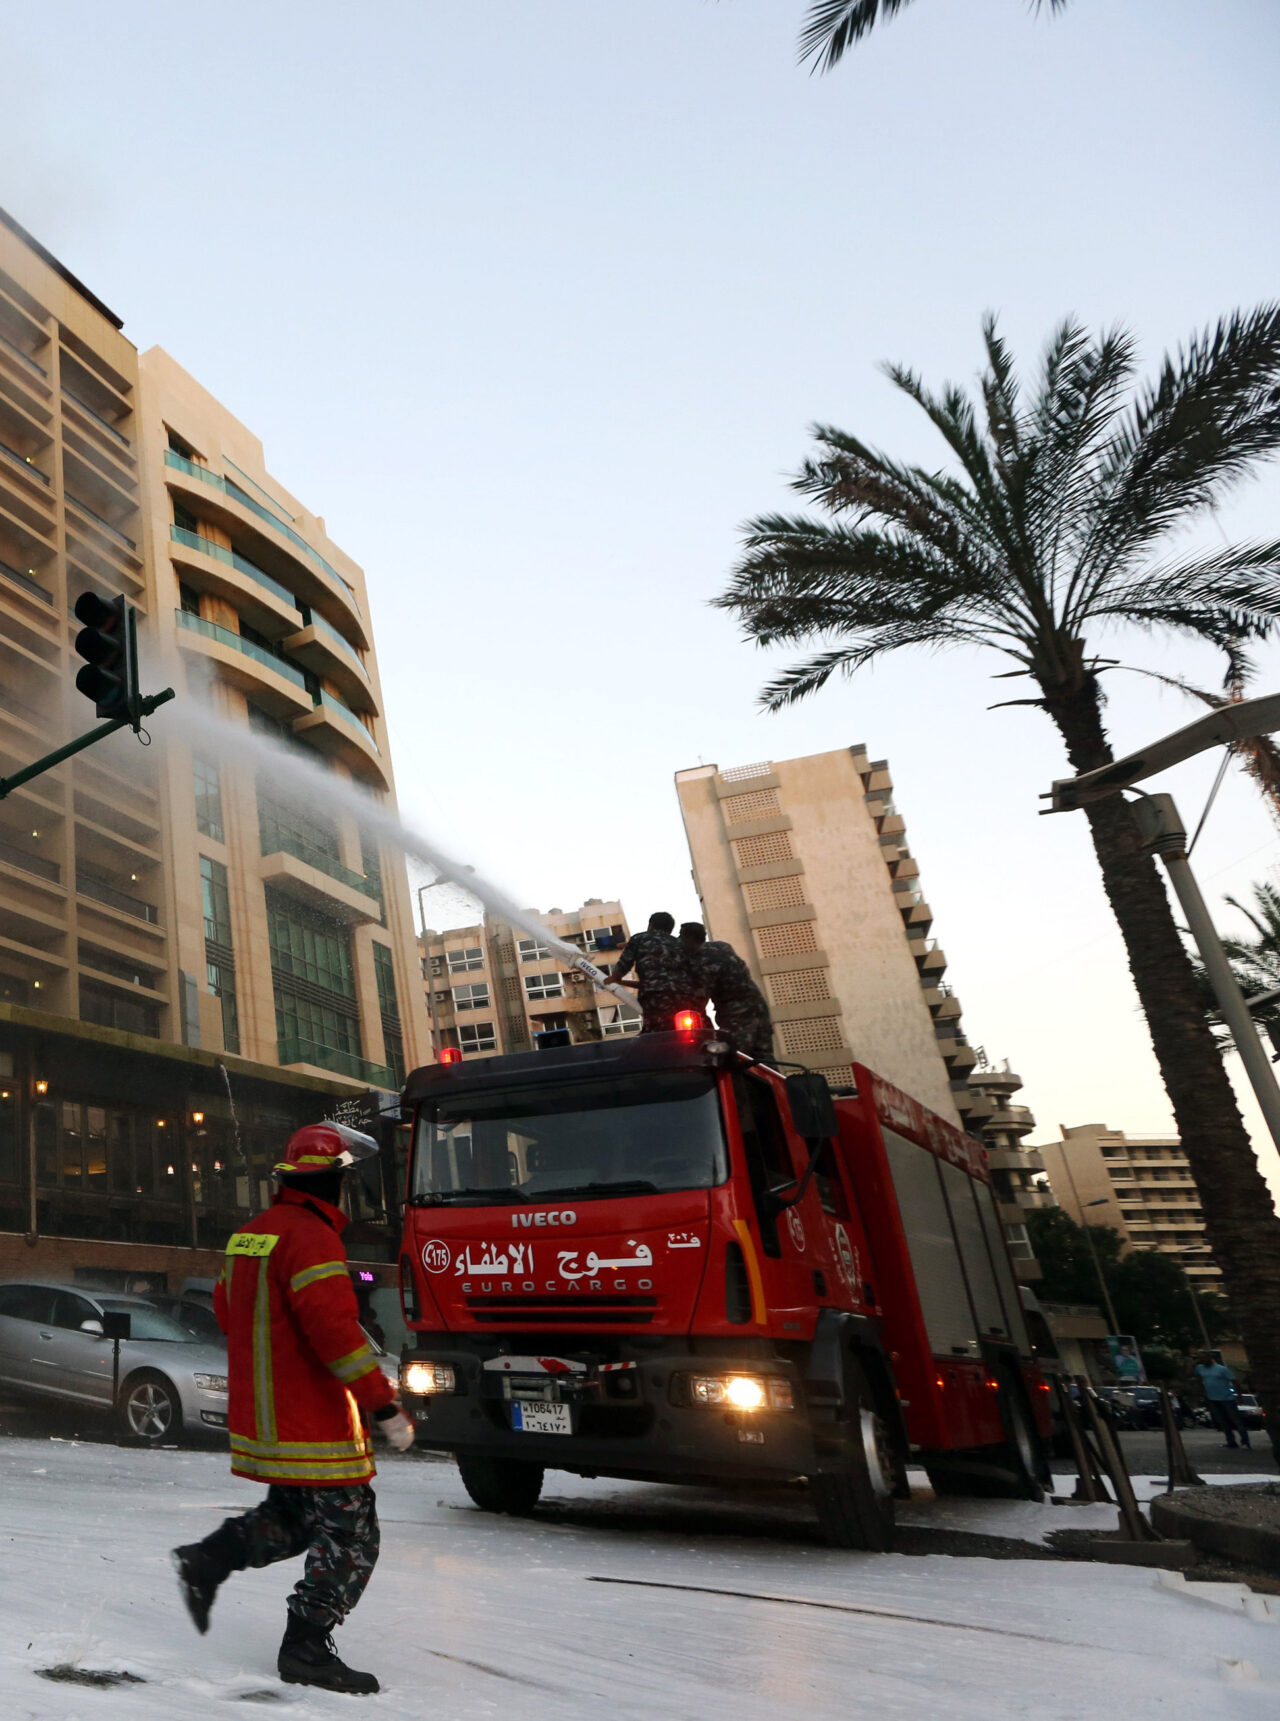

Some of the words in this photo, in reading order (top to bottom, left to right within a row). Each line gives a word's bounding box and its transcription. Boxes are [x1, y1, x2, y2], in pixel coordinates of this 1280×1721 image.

[580, 961, 597, 976] IVECO
[512, 1210, 577, 1228] IVECO
[432, 1249, 447, 1266] 175
[557, 1239, 653, 1280] فوج
[461, 1278, 653, 1293] EUROCARGO
[529, 1402, 563, 1415] 106417
